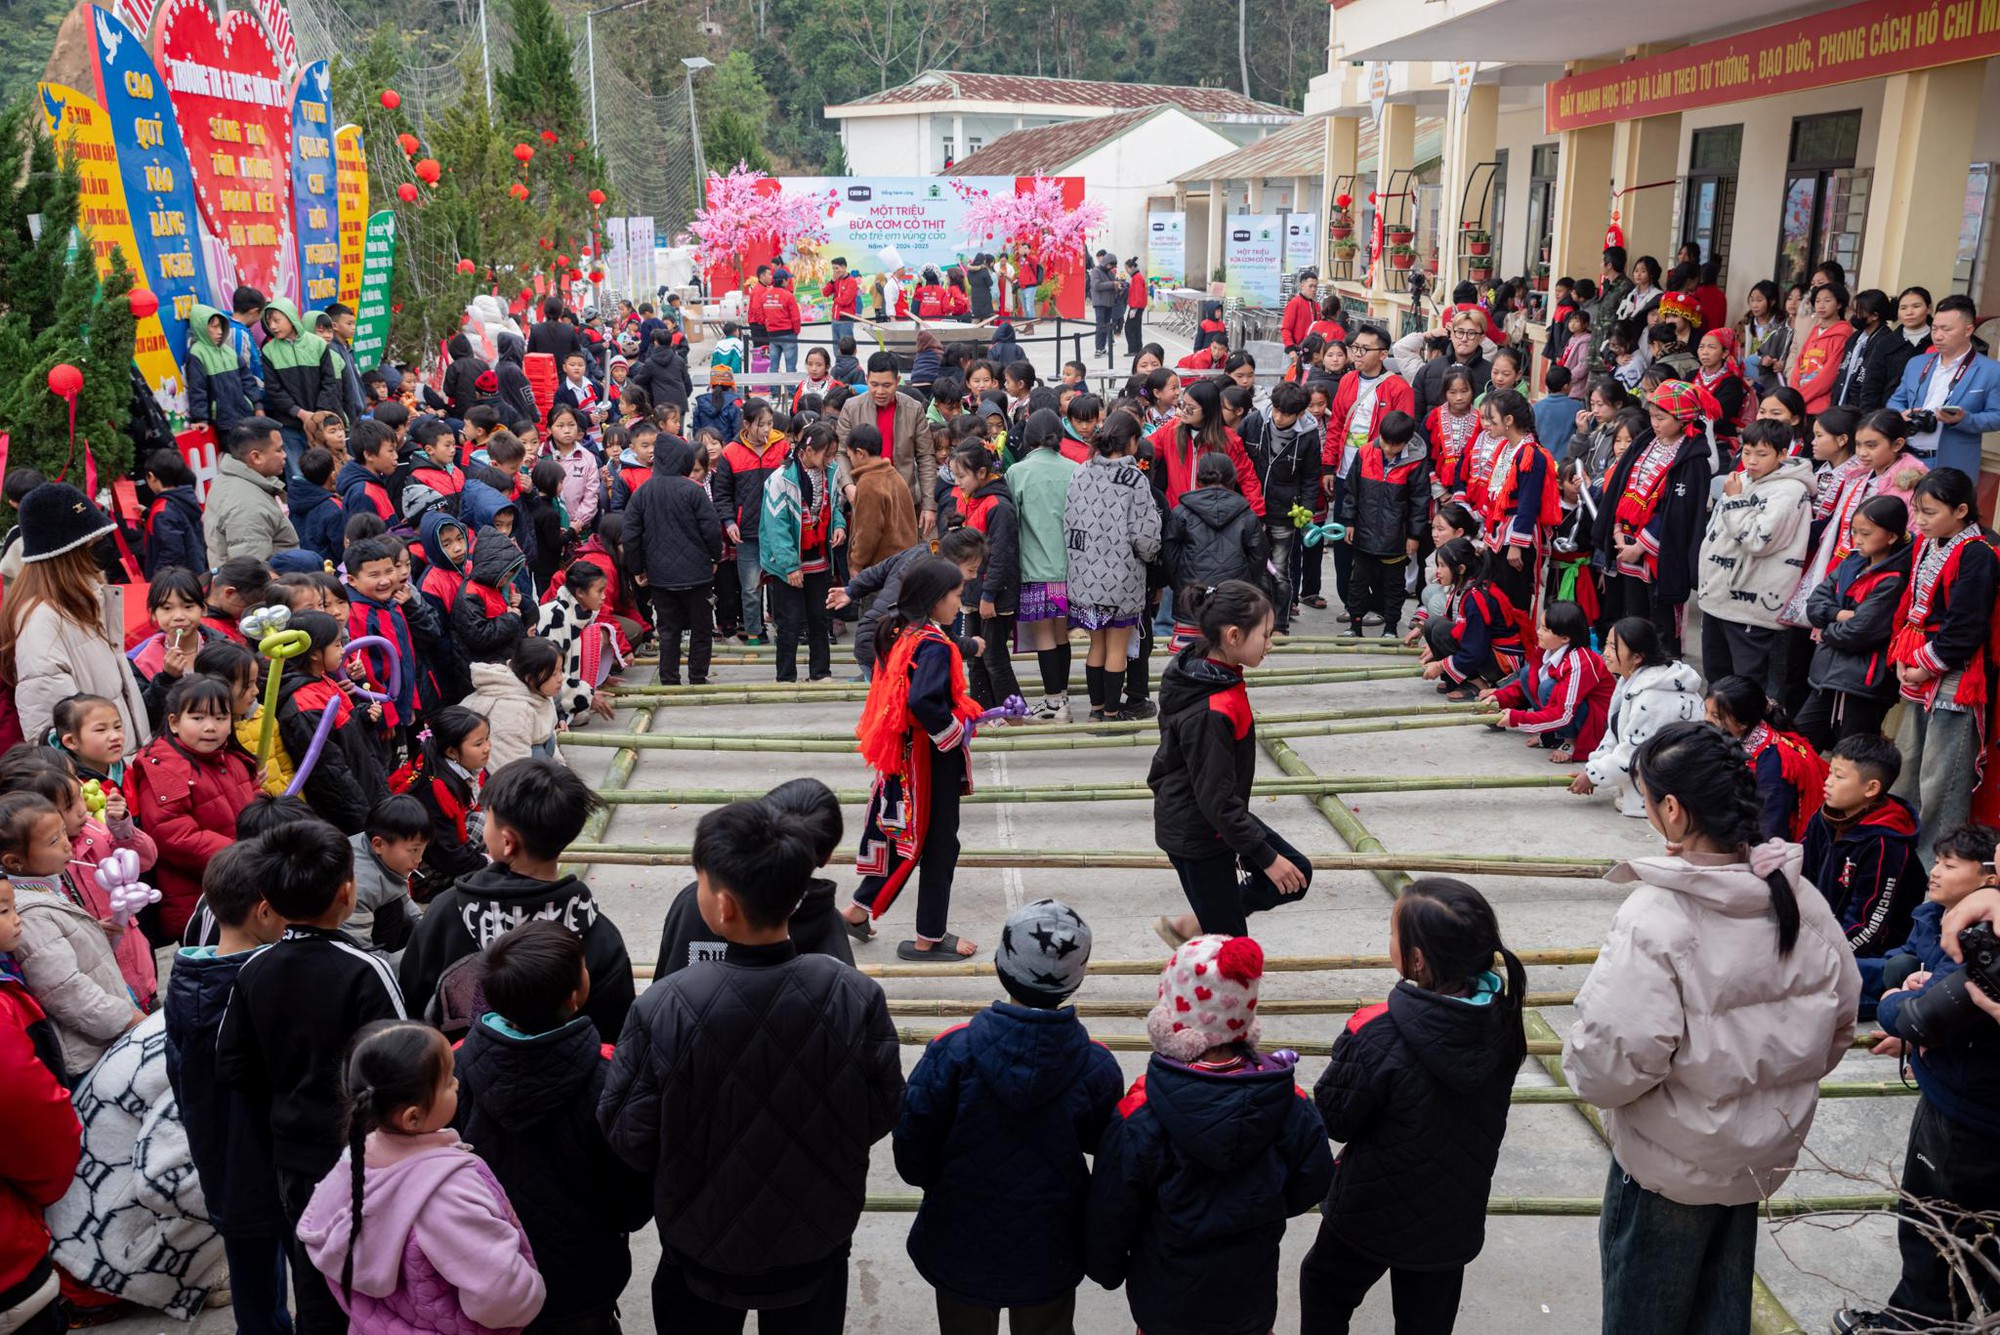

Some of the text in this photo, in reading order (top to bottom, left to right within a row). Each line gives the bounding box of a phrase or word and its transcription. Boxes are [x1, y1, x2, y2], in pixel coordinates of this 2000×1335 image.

[259, 0, 296, 68] HÚC
[1576, 87, 1600, 118] MẠNH
[1602, 83, 1619, 113] HỌC
[1620, 75, 1637, 110] TẬP
[1639, 72, 1651, 102] VÀ
[1651, 68, 1672, 100] LÀM
[1673, 65, 1697, 95] THEO
[1700, 59, 1714, 91] TƯ
[1714, 45, 1749, 88] TƯỞNG
[1758, 46, 1783, 84] ĐẠO
[1785, 32, 1814, 74] ĐỨC,
[1818, 26, 1866, 68] PHONG
[1869, 13, 1912, 57] CÁCH
[124, 70, 153, 100] CAO
[66, 105, 92, 126] 5 XIN
[299, 100, 327, 124] VINH
[135, 112, 164, 149] QUÝ
[208, 112, 242, 143] SÁNG
[210, 148, 237, 177] TÔN
[298, 135, 330, 161] QUANG
[144, 158, 174, 193] NÀO
[849, 217, 873, 230] BỮA
[875, 218, 902, 230] CƠM
[922, 220, 946, 232] THỊT
[870, 204, 925, 218] MỘT TRIỆU
[849, 231, 867, 240] cho
[869, 230, 883, 240] trẻ
[902, 230, 926, 242] vùng
[158, 239, 196, 279] NGHỀ
